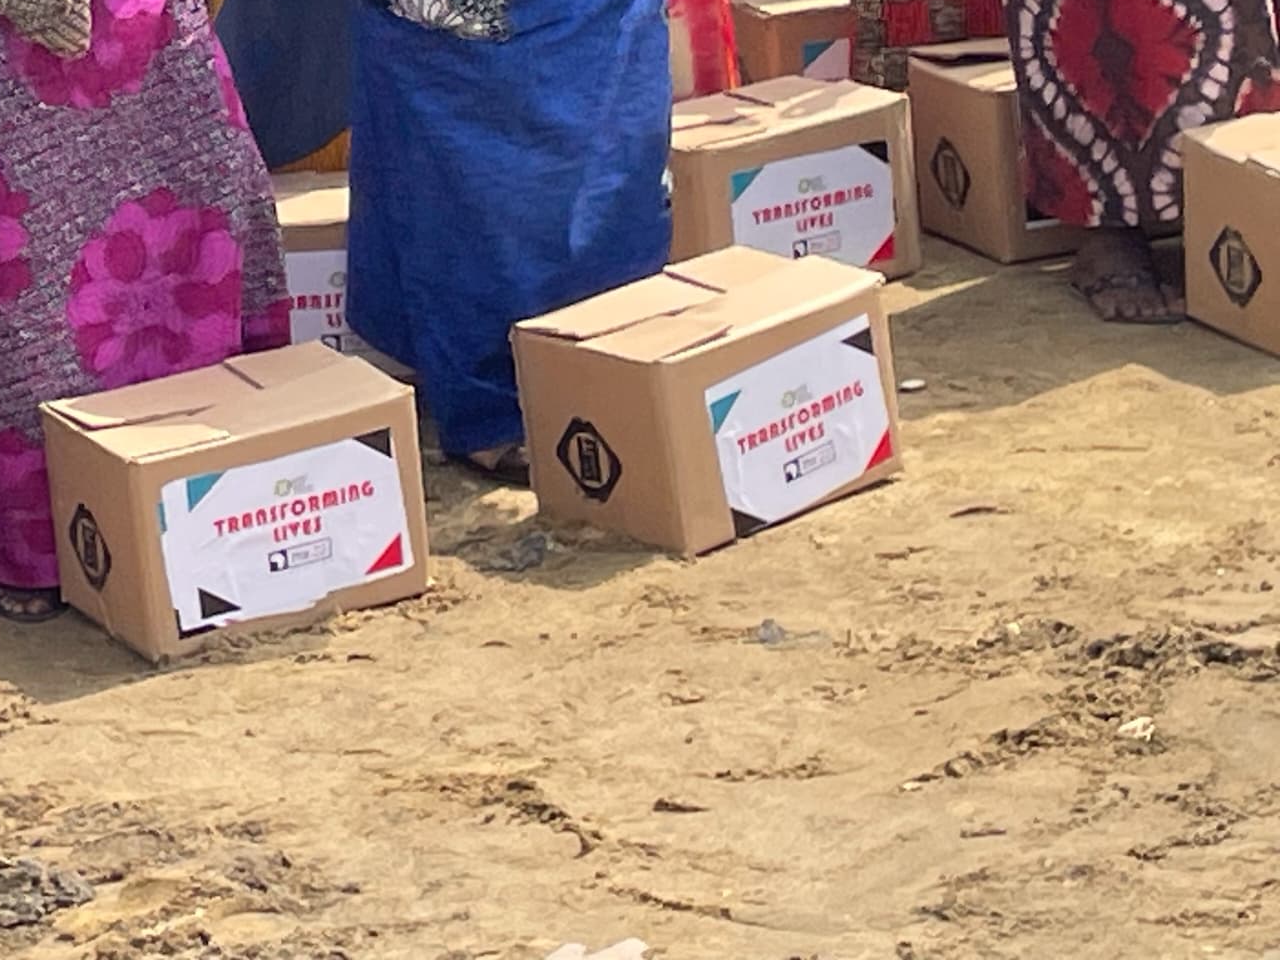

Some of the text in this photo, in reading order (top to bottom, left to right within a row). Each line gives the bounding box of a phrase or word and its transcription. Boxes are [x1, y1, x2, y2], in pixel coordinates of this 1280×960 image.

[752, 184, 874, 225] TRANSFORMING
[796, 213, 833, 233] LIVES
[737, 380, 864, 455] TRANSFORMING
[785, 422, 825, 453] LIVES
[213, 481, 375, 537] TRANSFORMING
[273, 516, 322, 542] LIVES
